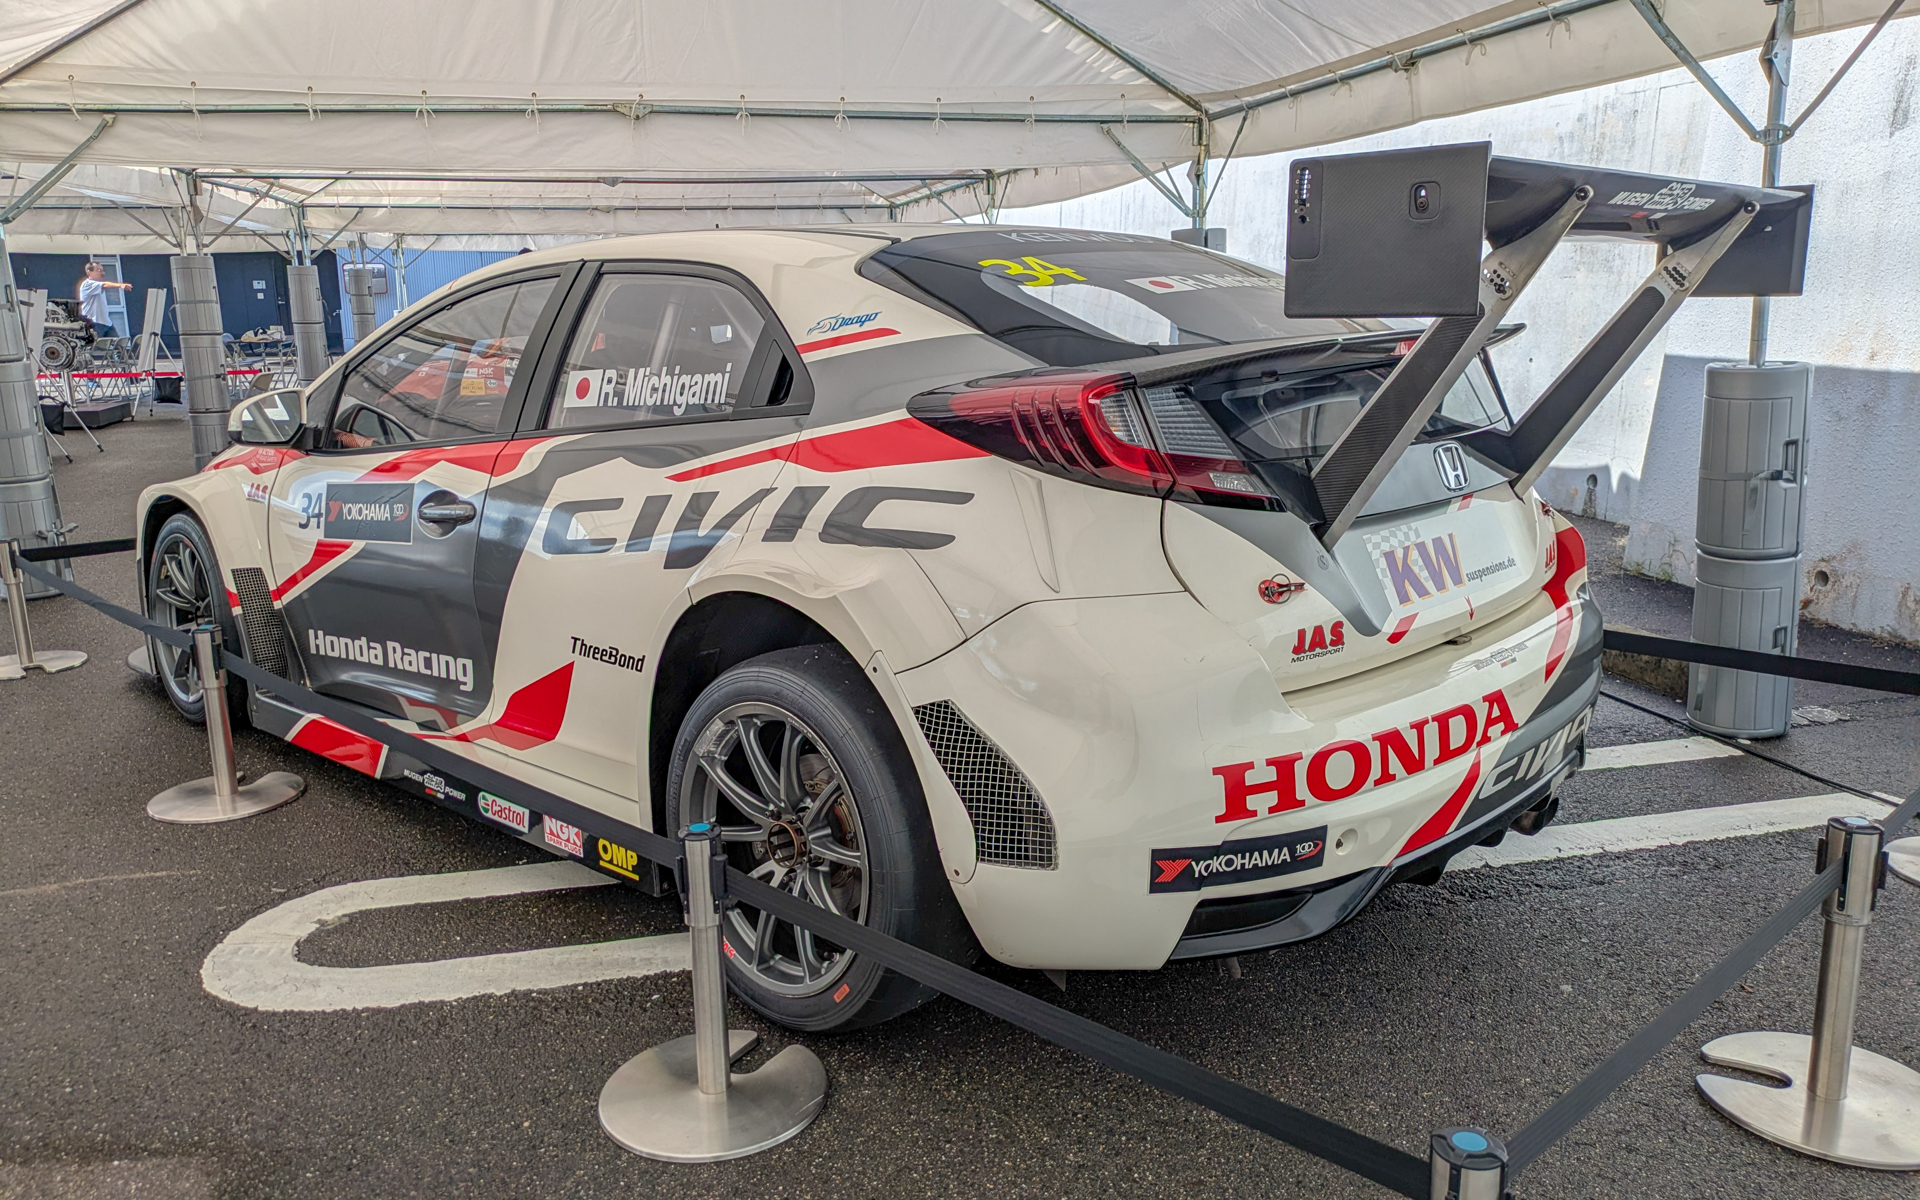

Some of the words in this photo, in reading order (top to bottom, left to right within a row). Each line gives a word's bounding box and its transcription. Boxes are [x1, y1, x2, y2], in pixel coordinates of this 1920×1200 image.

[1606, 191, 1655, 206] MUGEN
[1677, 196, 1716, 210] POWER
[977, 256, 1088, 287] 34
[830, 311, 883, 331] Drago
[599, 369, 618, 407] R.
[622, 362, 733, 416] Michigami
[246, 482, 269, 500] JAS
[298, 492, 323, 530] 34
[342, 503, 391, 521] YOKOHAMA
[541, 485, 977, 570] CIVIC
[1382, 532, 1467, 607] KW
[1465, 556, 1517, 582] suspensions.de
[570, 635, 646, 673] ThreeBond
[1290, 646, 1344, 664] MOTORSPORT
[1291, 620, 1345, 656] JAS
[308, 629, 383, 666] Honda
[386, 640, 474, 692] Racing
[1212, 689, 1519, 824] HONDA
[403, 768, 424, 783] MUGEN
[444, 786, 466, 802] POWER
[490, 798, 526, 829] Castrol
[544, 814, 582, 848] NGK
[546, 834, 564, 849] SPARK
[563, 842, 583, 856] PLUGS
[598, 837, 638, 871] OMP
[1191, 846, 1291, 878] YOKOHAMA
